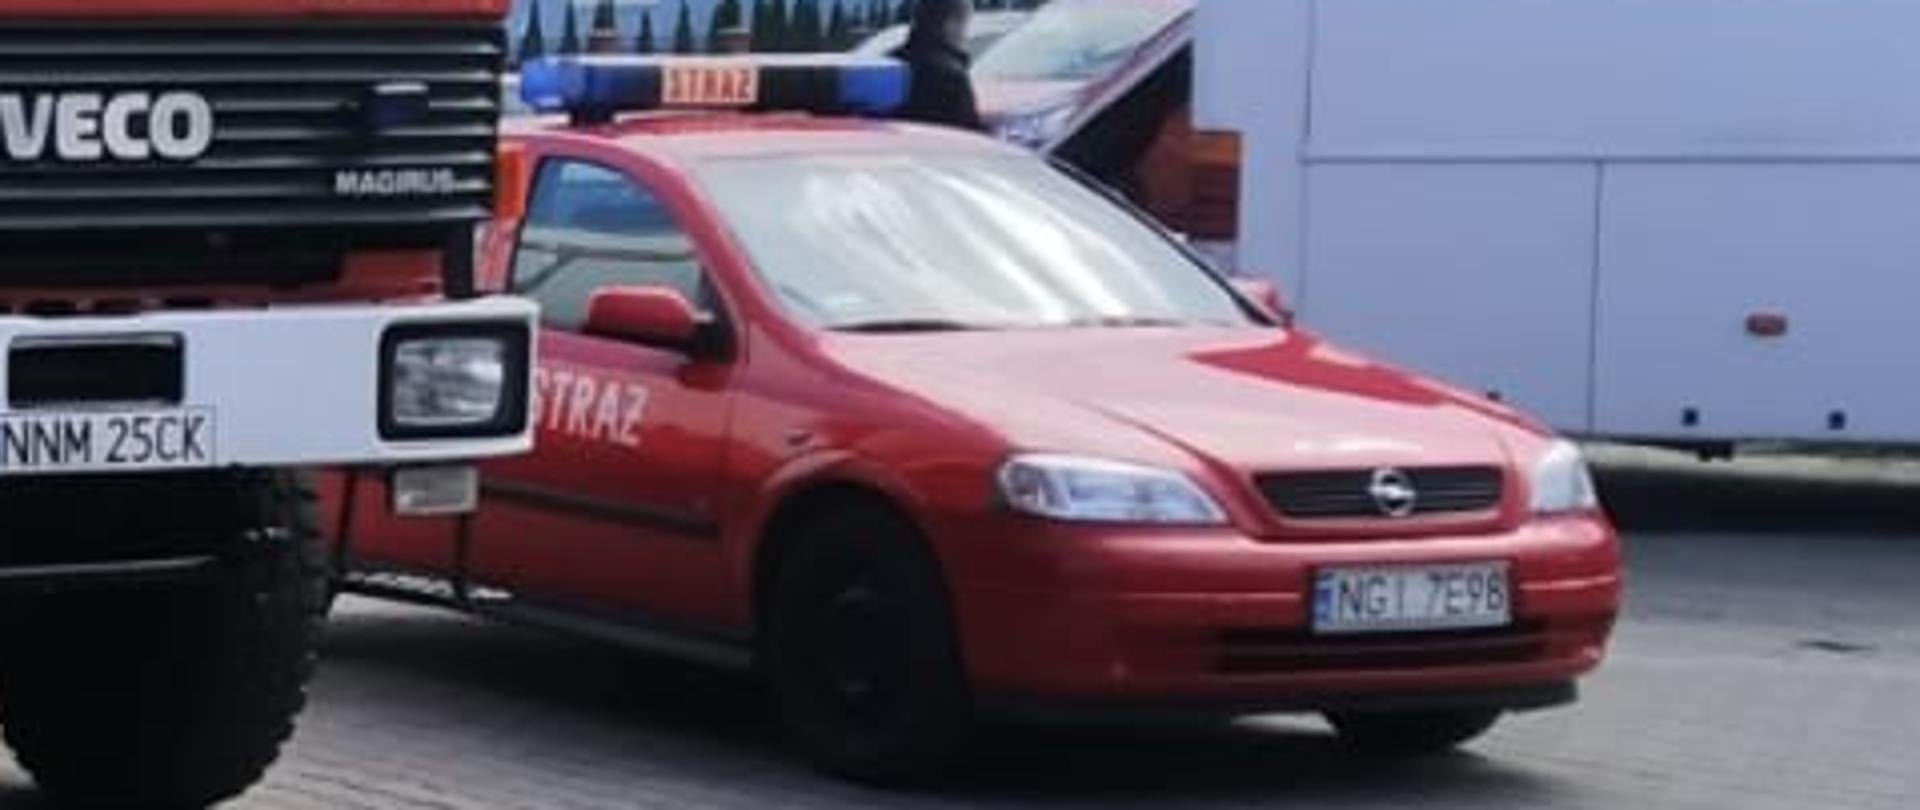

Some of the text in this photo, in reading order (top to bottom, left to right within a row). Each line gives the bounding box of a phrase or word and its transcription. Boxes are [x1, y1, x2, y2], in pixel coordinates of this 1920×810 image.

[0, 92, 212, 159] VECO
[335, 169, 454, 195] MAGIRUS
[2, 415, 205, 464] NNM 25CK
